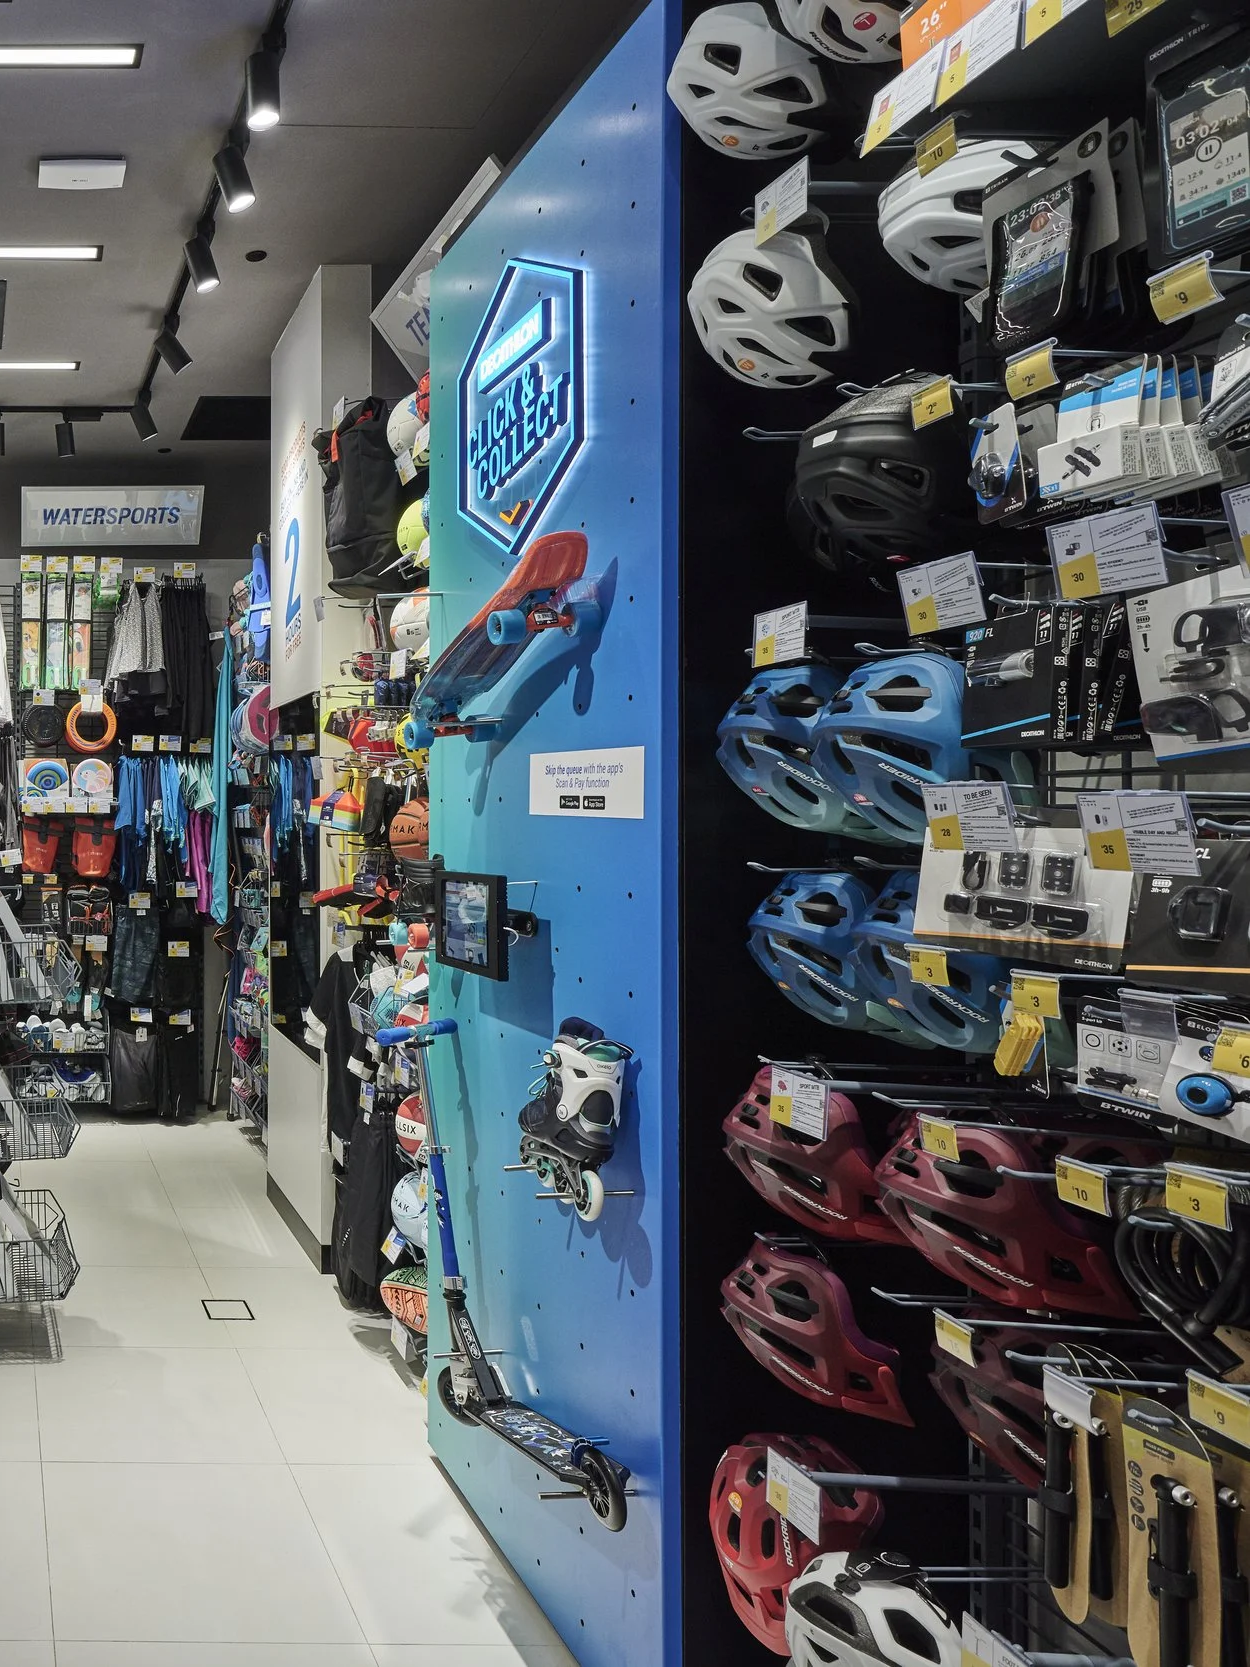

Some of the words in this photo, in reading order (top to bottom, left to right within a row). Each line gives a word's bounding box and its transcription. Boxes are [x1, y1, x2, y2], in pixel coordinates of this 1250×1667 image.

[809, 31, 861, 63] ROCKRIDER
[1150, 37, 1184, 61] DECATHLON
[480, 311, 540, 382] DECATHLON
[469, 378, 519, 469] CLICK
[521, 363, 535, 410] &
[477, 376, 564, 500] COLLECT
[42, 506, 181, 526] WATERSPORTS
[285, 517, 301, 629] 2
[969, 630, 983, 642] 920
[985, 627, 994, 639] FL
[1021, 730, 1045, 738] DECATHLON
[545, 765, 556, 777] Skip
[557, 764, 565, 775] the
[566, 765, 582, 777] queue
[583, 763, 596, 774] with
[596, 762, 606, 773] the
[607, 762, 624, 776] app's
[877, 762, 925, 787] KRIDER
[555, 778, 569, 788] Scan
[574, 777, 585, 791] Pay
[585, 776, 610, 789] function
[979, 789, 993, 797] SEEN
[1074, 958, 1113, 970] DECATHLON
[798, 964, 859, 1002] ROCKRIDER
[1100, 1102, 1151, 1120] BTWIN
[396, 1119, 417, 1136] LLSIX
[783, 1185, 848, 1220] ROCKRIDER
[953, 1245, 1035, 1288] ROCKRIDER
[771, 1355, 834, 1396] ROCKRIDER
